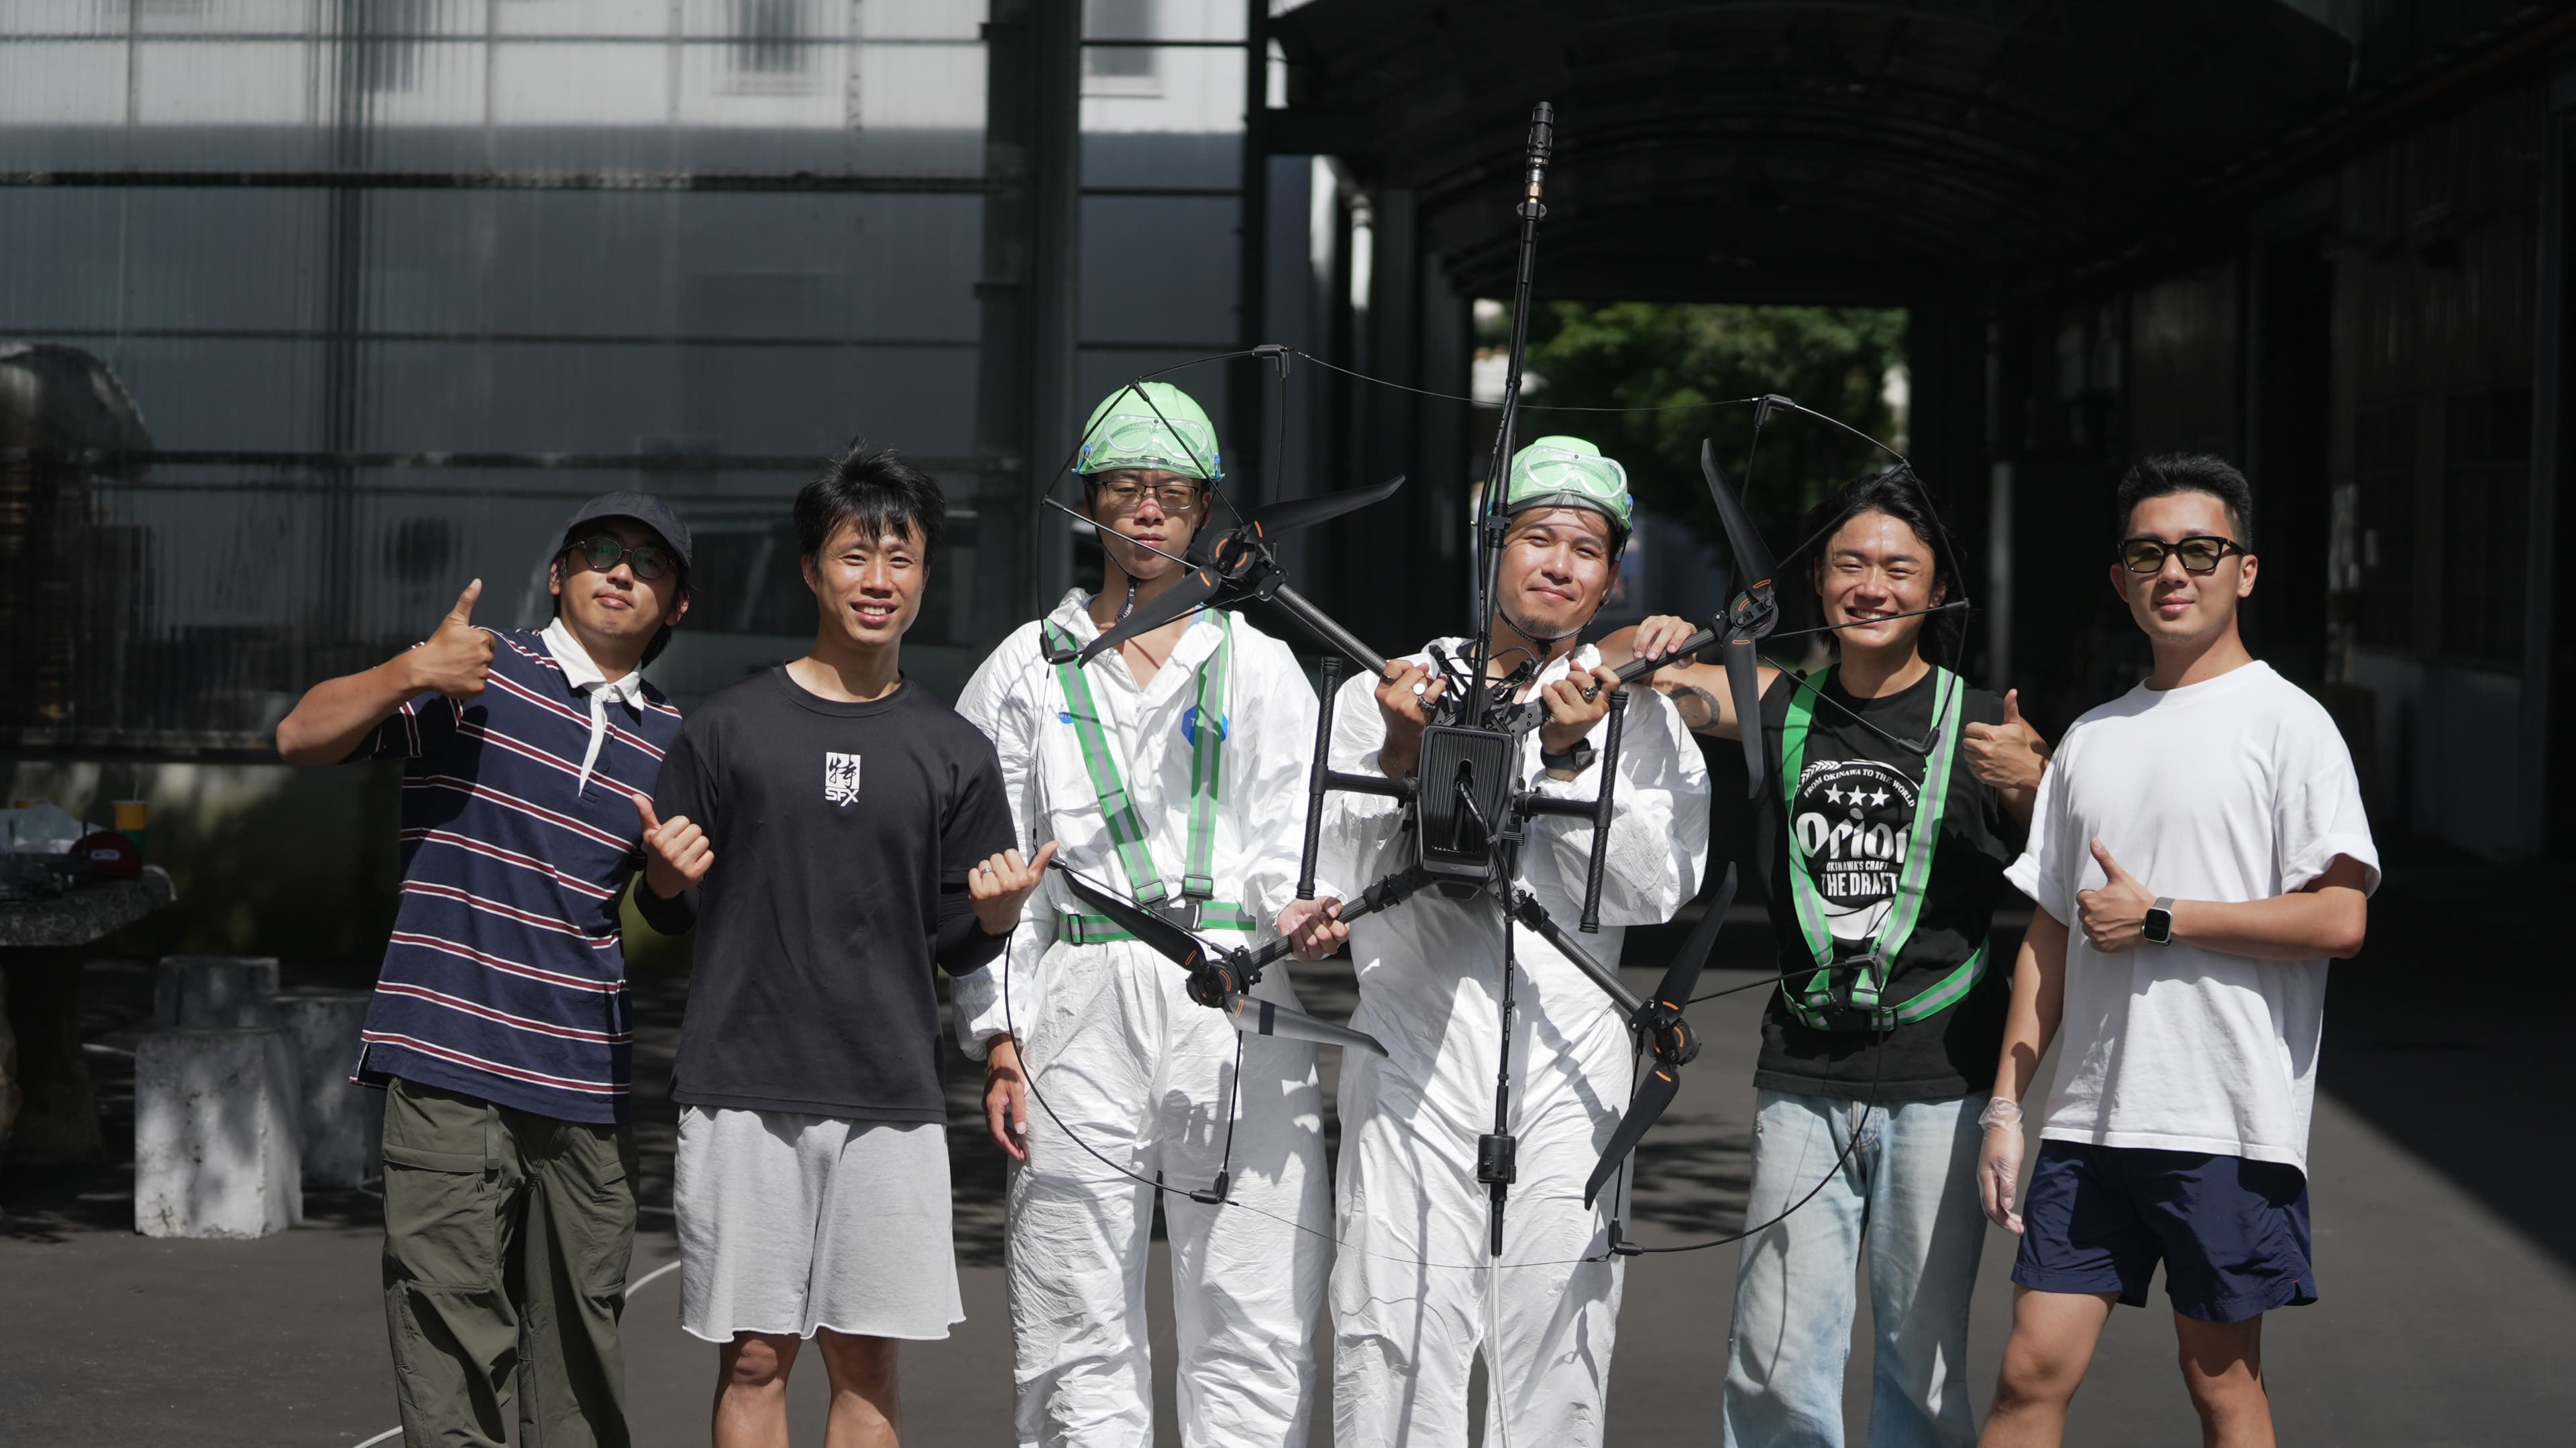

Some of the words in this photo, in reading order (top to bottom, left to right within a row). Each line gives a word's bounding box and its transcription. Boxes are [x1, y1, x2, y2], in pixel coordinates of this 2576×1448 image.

[827, 753, 859, 789] 特
[825, 787, 859, 807] SFX
[1803, 776, 1823, 797] FROM
[1823, 769, 1861, 781] OKINAWA
[1862, 769, 1874, 777] TO
[1875, 771, 1892, 784] THE
[1892, 779, 1915, 807] WORLD
[1826, 860, 1864, 871] OKINAWA'S
[1865, 860, 1889, 871] CRAFT
[1821, 873, 1847, 896] THE
[1849, 872, 1898, 895] DRAFT
